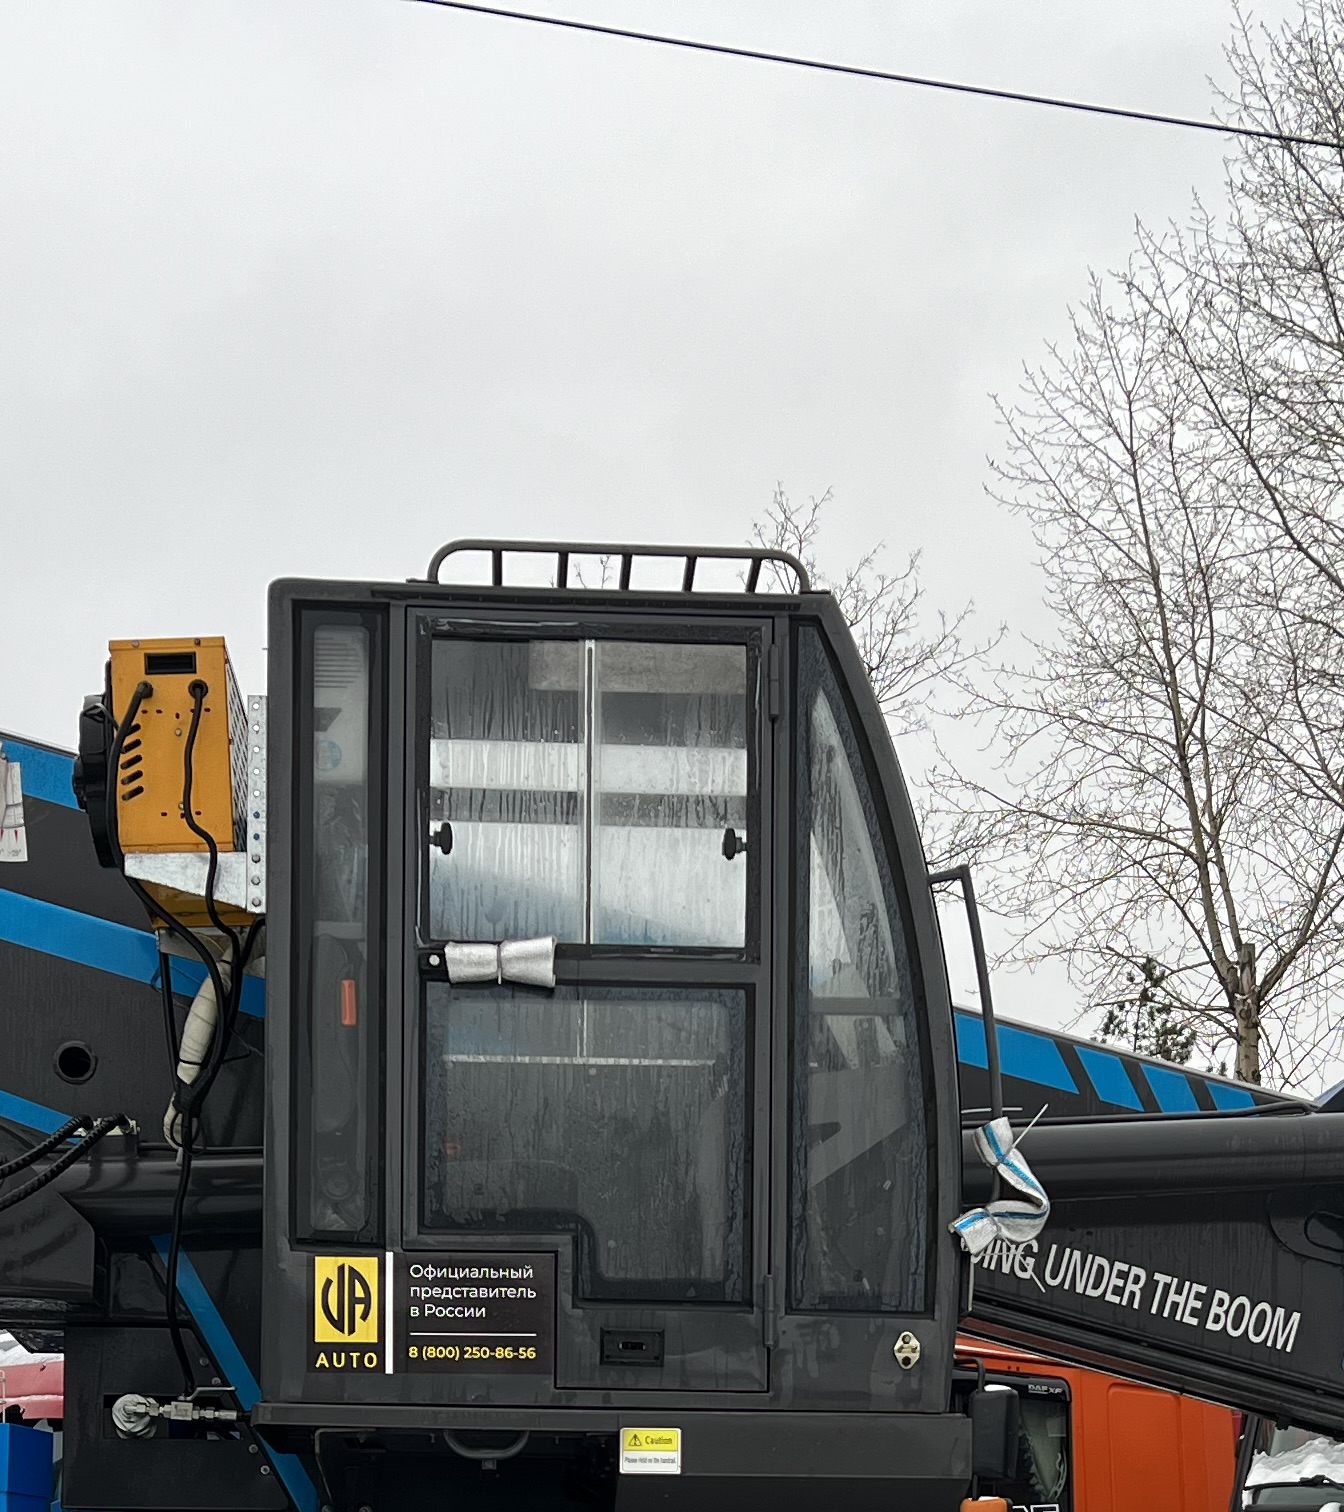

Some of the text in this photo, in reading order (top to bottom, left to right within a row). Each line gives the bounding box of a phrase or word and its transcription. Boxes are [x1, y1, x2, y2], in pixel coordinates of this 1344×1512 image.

[409, 1264, 534, 1281] Официальный
[410, 1286, 537, 1300] представитель
[1044, 1244, 1146, 1310] UNDER
[1150, 1272, 1208, 1326] THE
[1205, 1289, 1301, 1353] BOOM
[410, 1305, 486, 1318] в России
[315, 1352, 378, 1369] AUTO
[408, 1346, 537, 1361] 8 (800) 250-86-56
